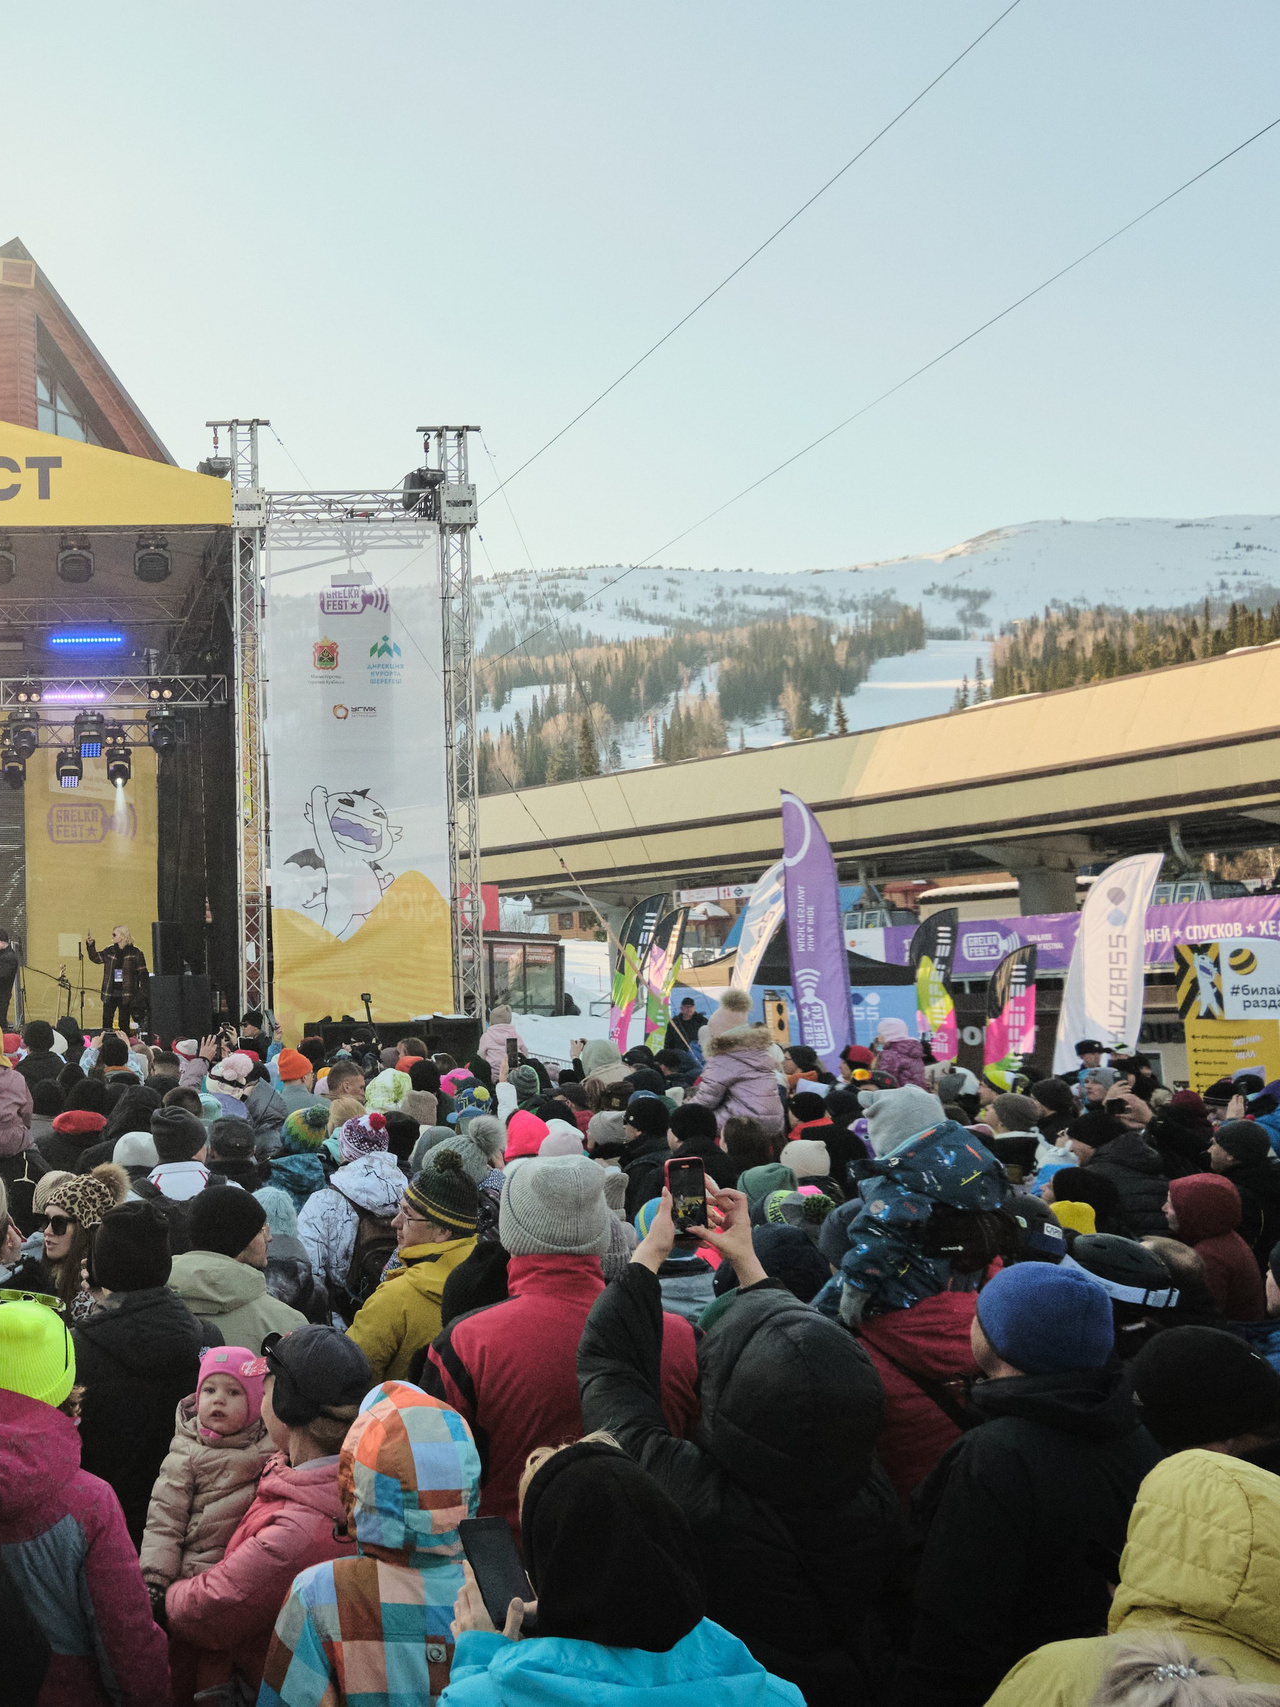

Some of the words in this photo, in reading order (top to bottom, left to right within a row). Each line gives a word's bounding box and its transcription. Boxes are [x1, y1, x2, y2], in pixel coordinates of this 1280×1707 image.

[326, 600, 349, 610] FEST
[56, 808, 99, 823] GRELKA
[56, 824, 84, 838] FEST
[1144, 926, 1171, 945] НЕЙ
[1185, 921, 1243, 940] СПУСКОВ
[1259, 920, 1280, 936] ХЕ
[969, 947, 990, 957] FEST
[1107, 934, 1128, 1044] KUZBASS
